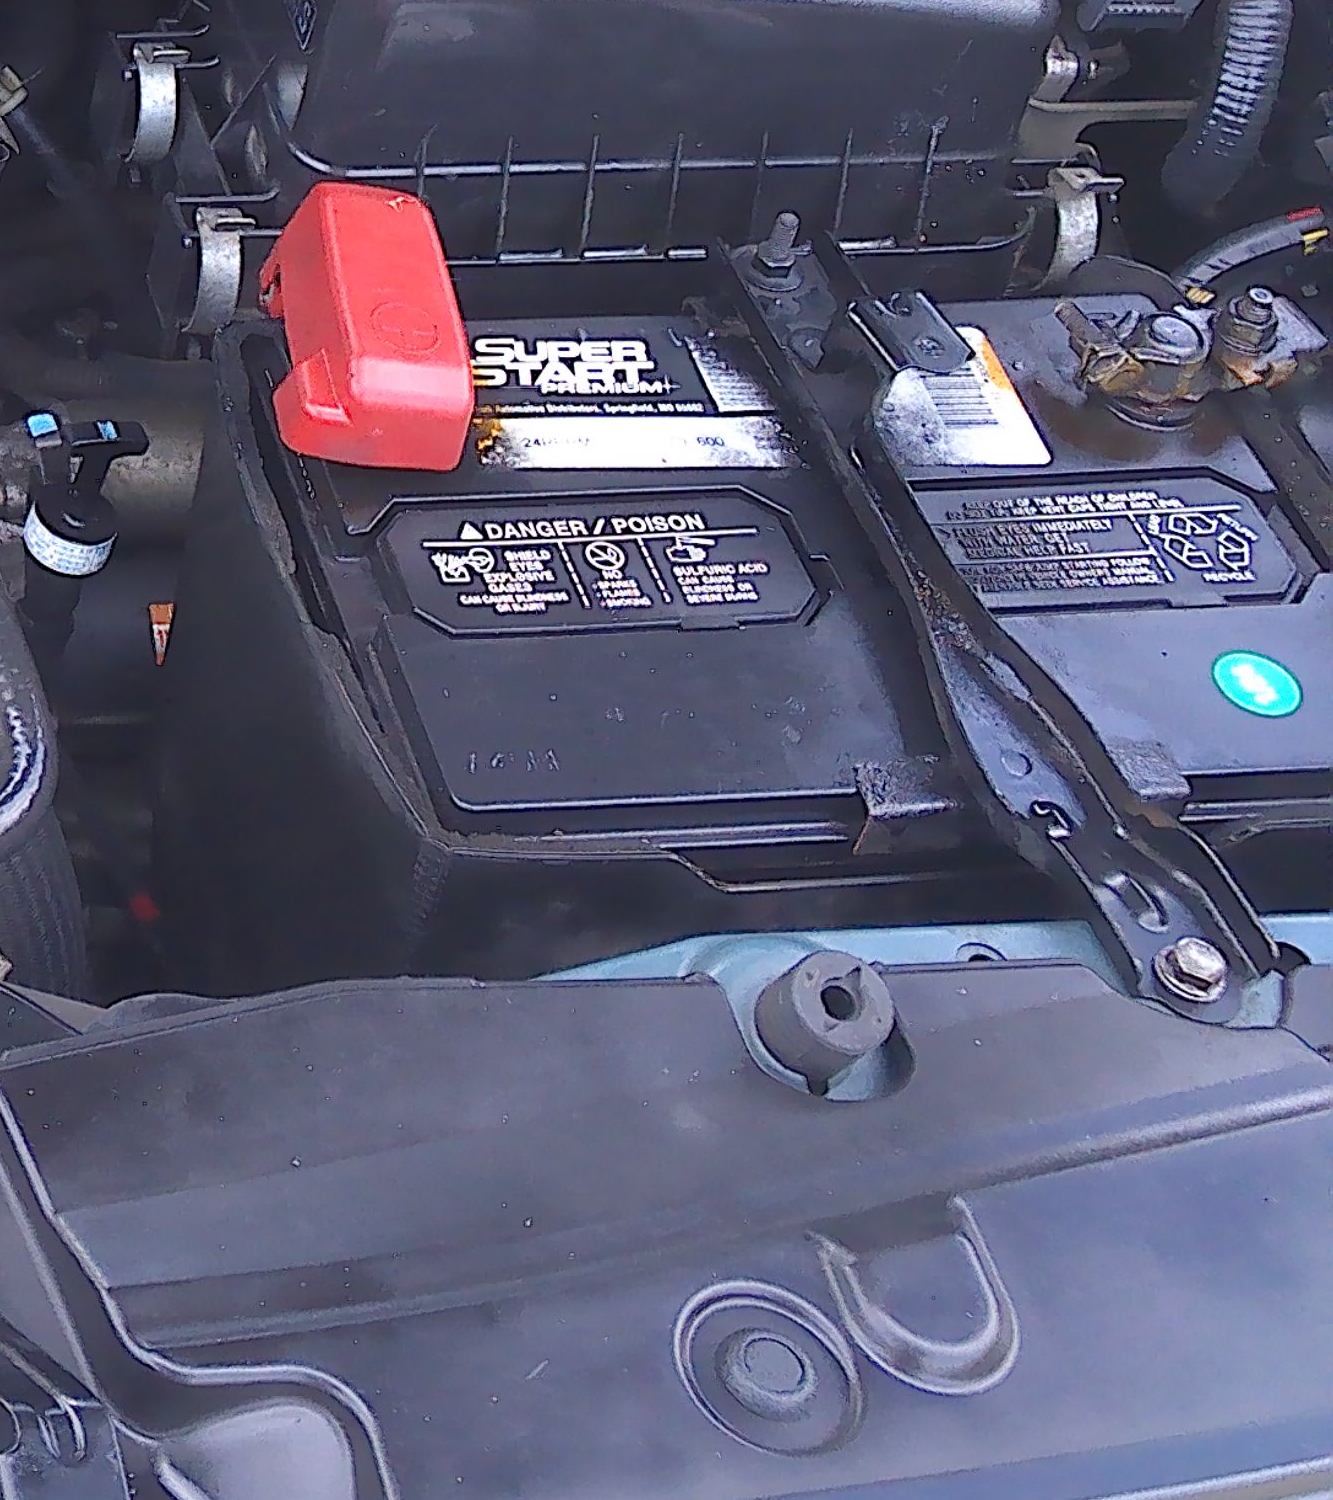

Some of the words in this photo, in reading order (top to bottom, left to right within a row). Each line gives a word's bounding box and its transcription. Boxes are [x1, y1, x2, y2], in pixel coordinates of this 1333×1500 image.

[474, 338, 647, 362] SUPER
[472, 360, 654, 388] START
[541, 380, 663, 394] PREMIUM
[485, 518, 590, 541] DANGER
[612, 513, 706, 535] POISON
[996, 523, 1031, 535] EYES
[1033, 518, 1113, 533] IMMEDIATELY
[1043, 531, 1070, 544] GET
[504, 549, 552, 562] SHIELD
[1023, 543, 1058, 557] HELP
[1058, 541, 1092, 555] FAST
[509, 561, 544, 572] EYES
[673, 565, 736, 577] SULFURIC
[738, 563, 769, 575] ACID
[483, 570, 555, 583] EXPLOSIVE
[602, 570, 623, 580] NO
[488, 582, 534, 593] GASES
